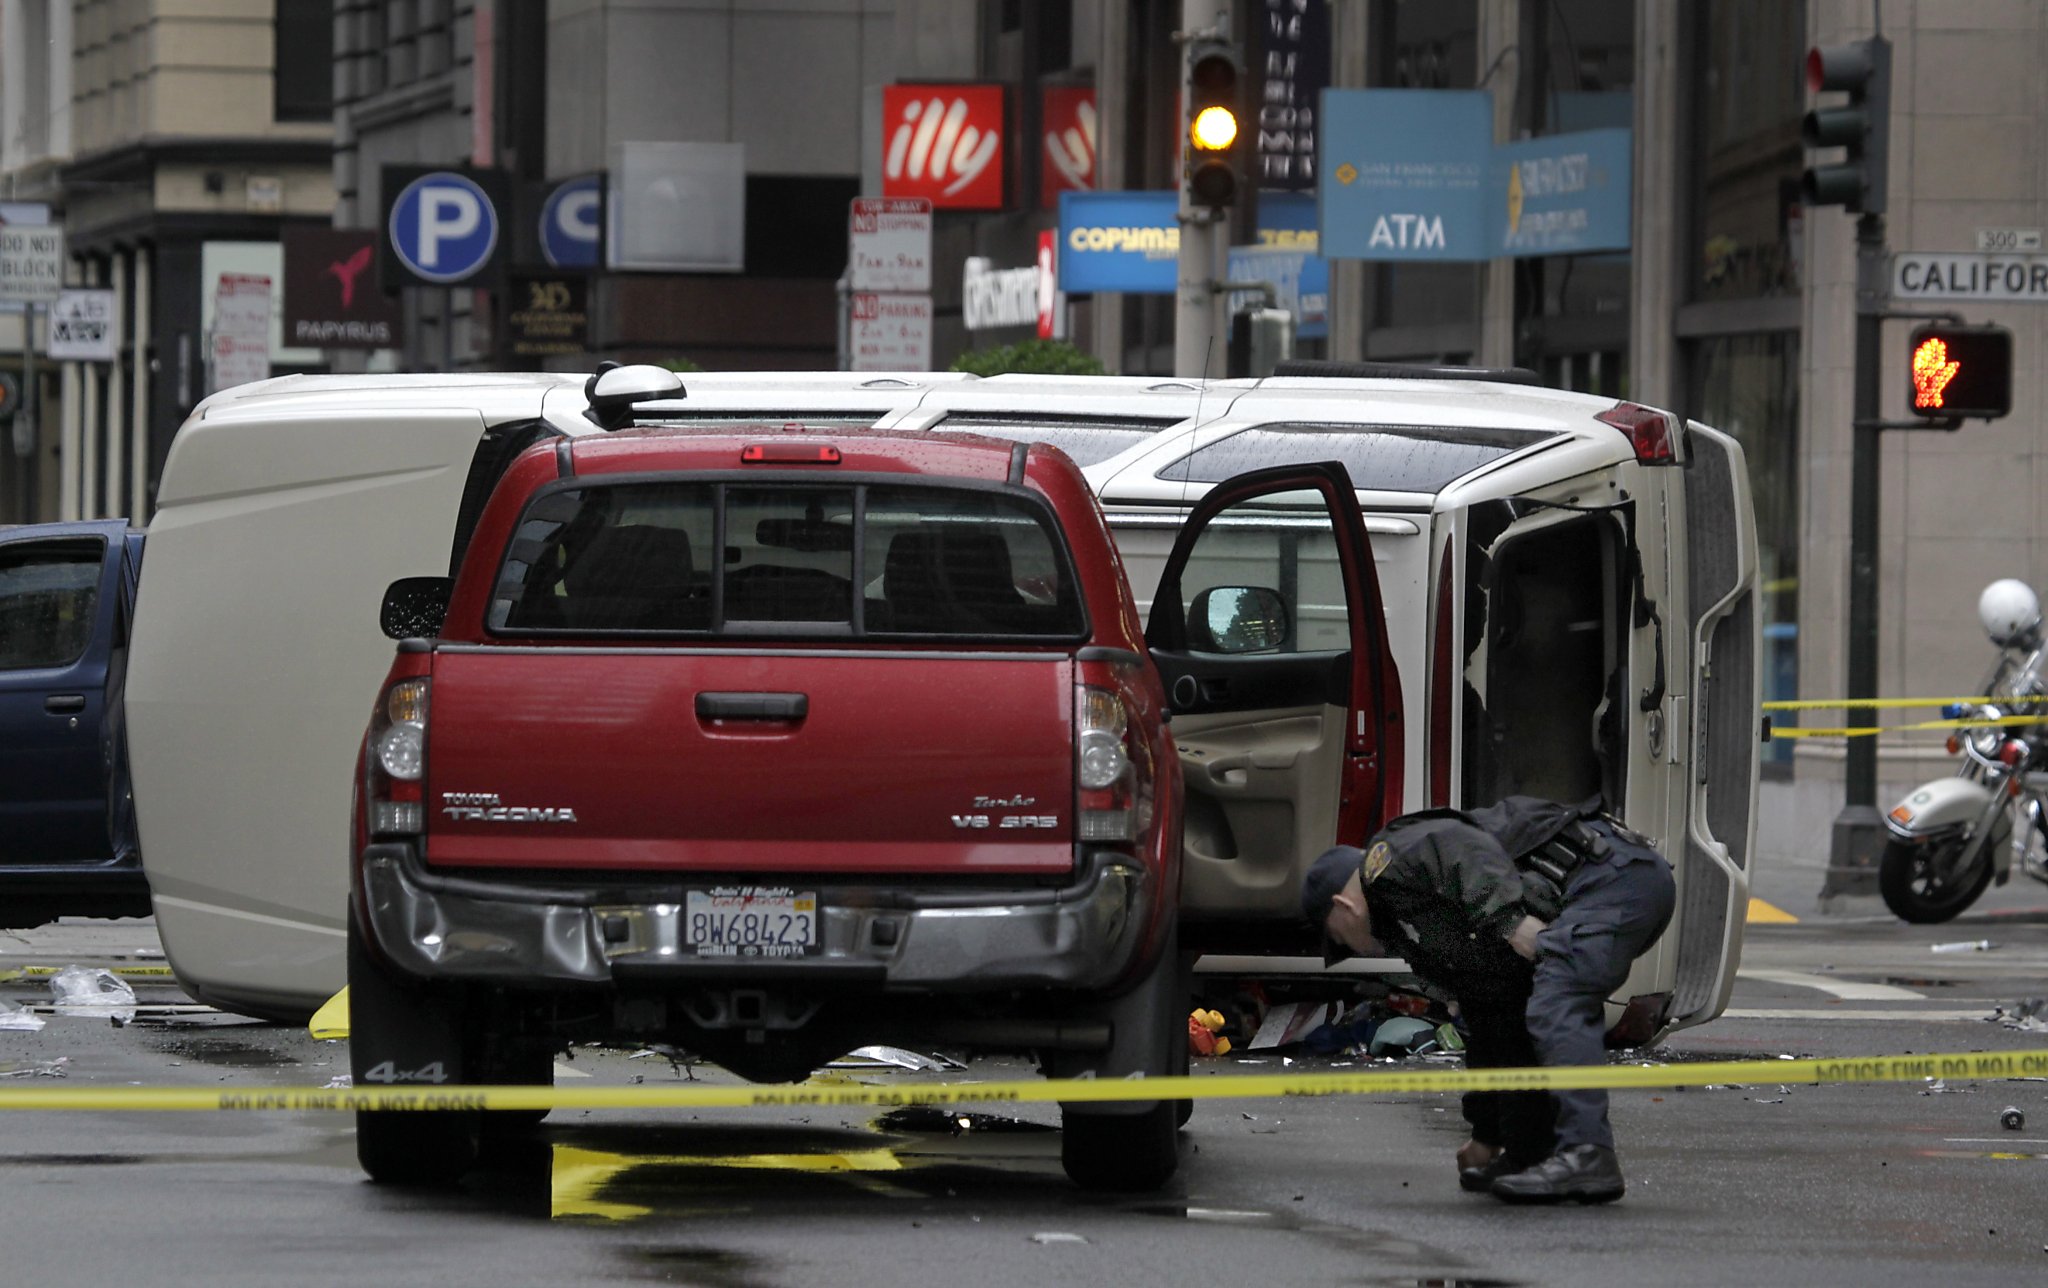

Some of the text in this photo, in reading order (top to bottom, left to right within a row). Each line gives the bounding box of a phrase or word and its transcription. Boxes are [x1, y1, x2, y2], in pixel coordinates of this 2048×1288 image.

[886, 97, 998, 196] illy
[418, 187, 482, 267] P
[855, 213, 875, 231] NO
[1368, 214, 1445, 248] ATM
[3, 234, 57, 251] DO NOT
[2, 258, 57, 279] BLOCK
[855, 295, 877, 317] NO
[297, 319, 392, 342] PAPYRUS
[442, 792, 501, 806] TOYOTA
[442, 807, 577, 823] TACOMA
[951, 815, 1058, 828] V6 SR5
[693, 913, 810, 946] 8W68423
[365, 1061, 448, 1084] 4x4
